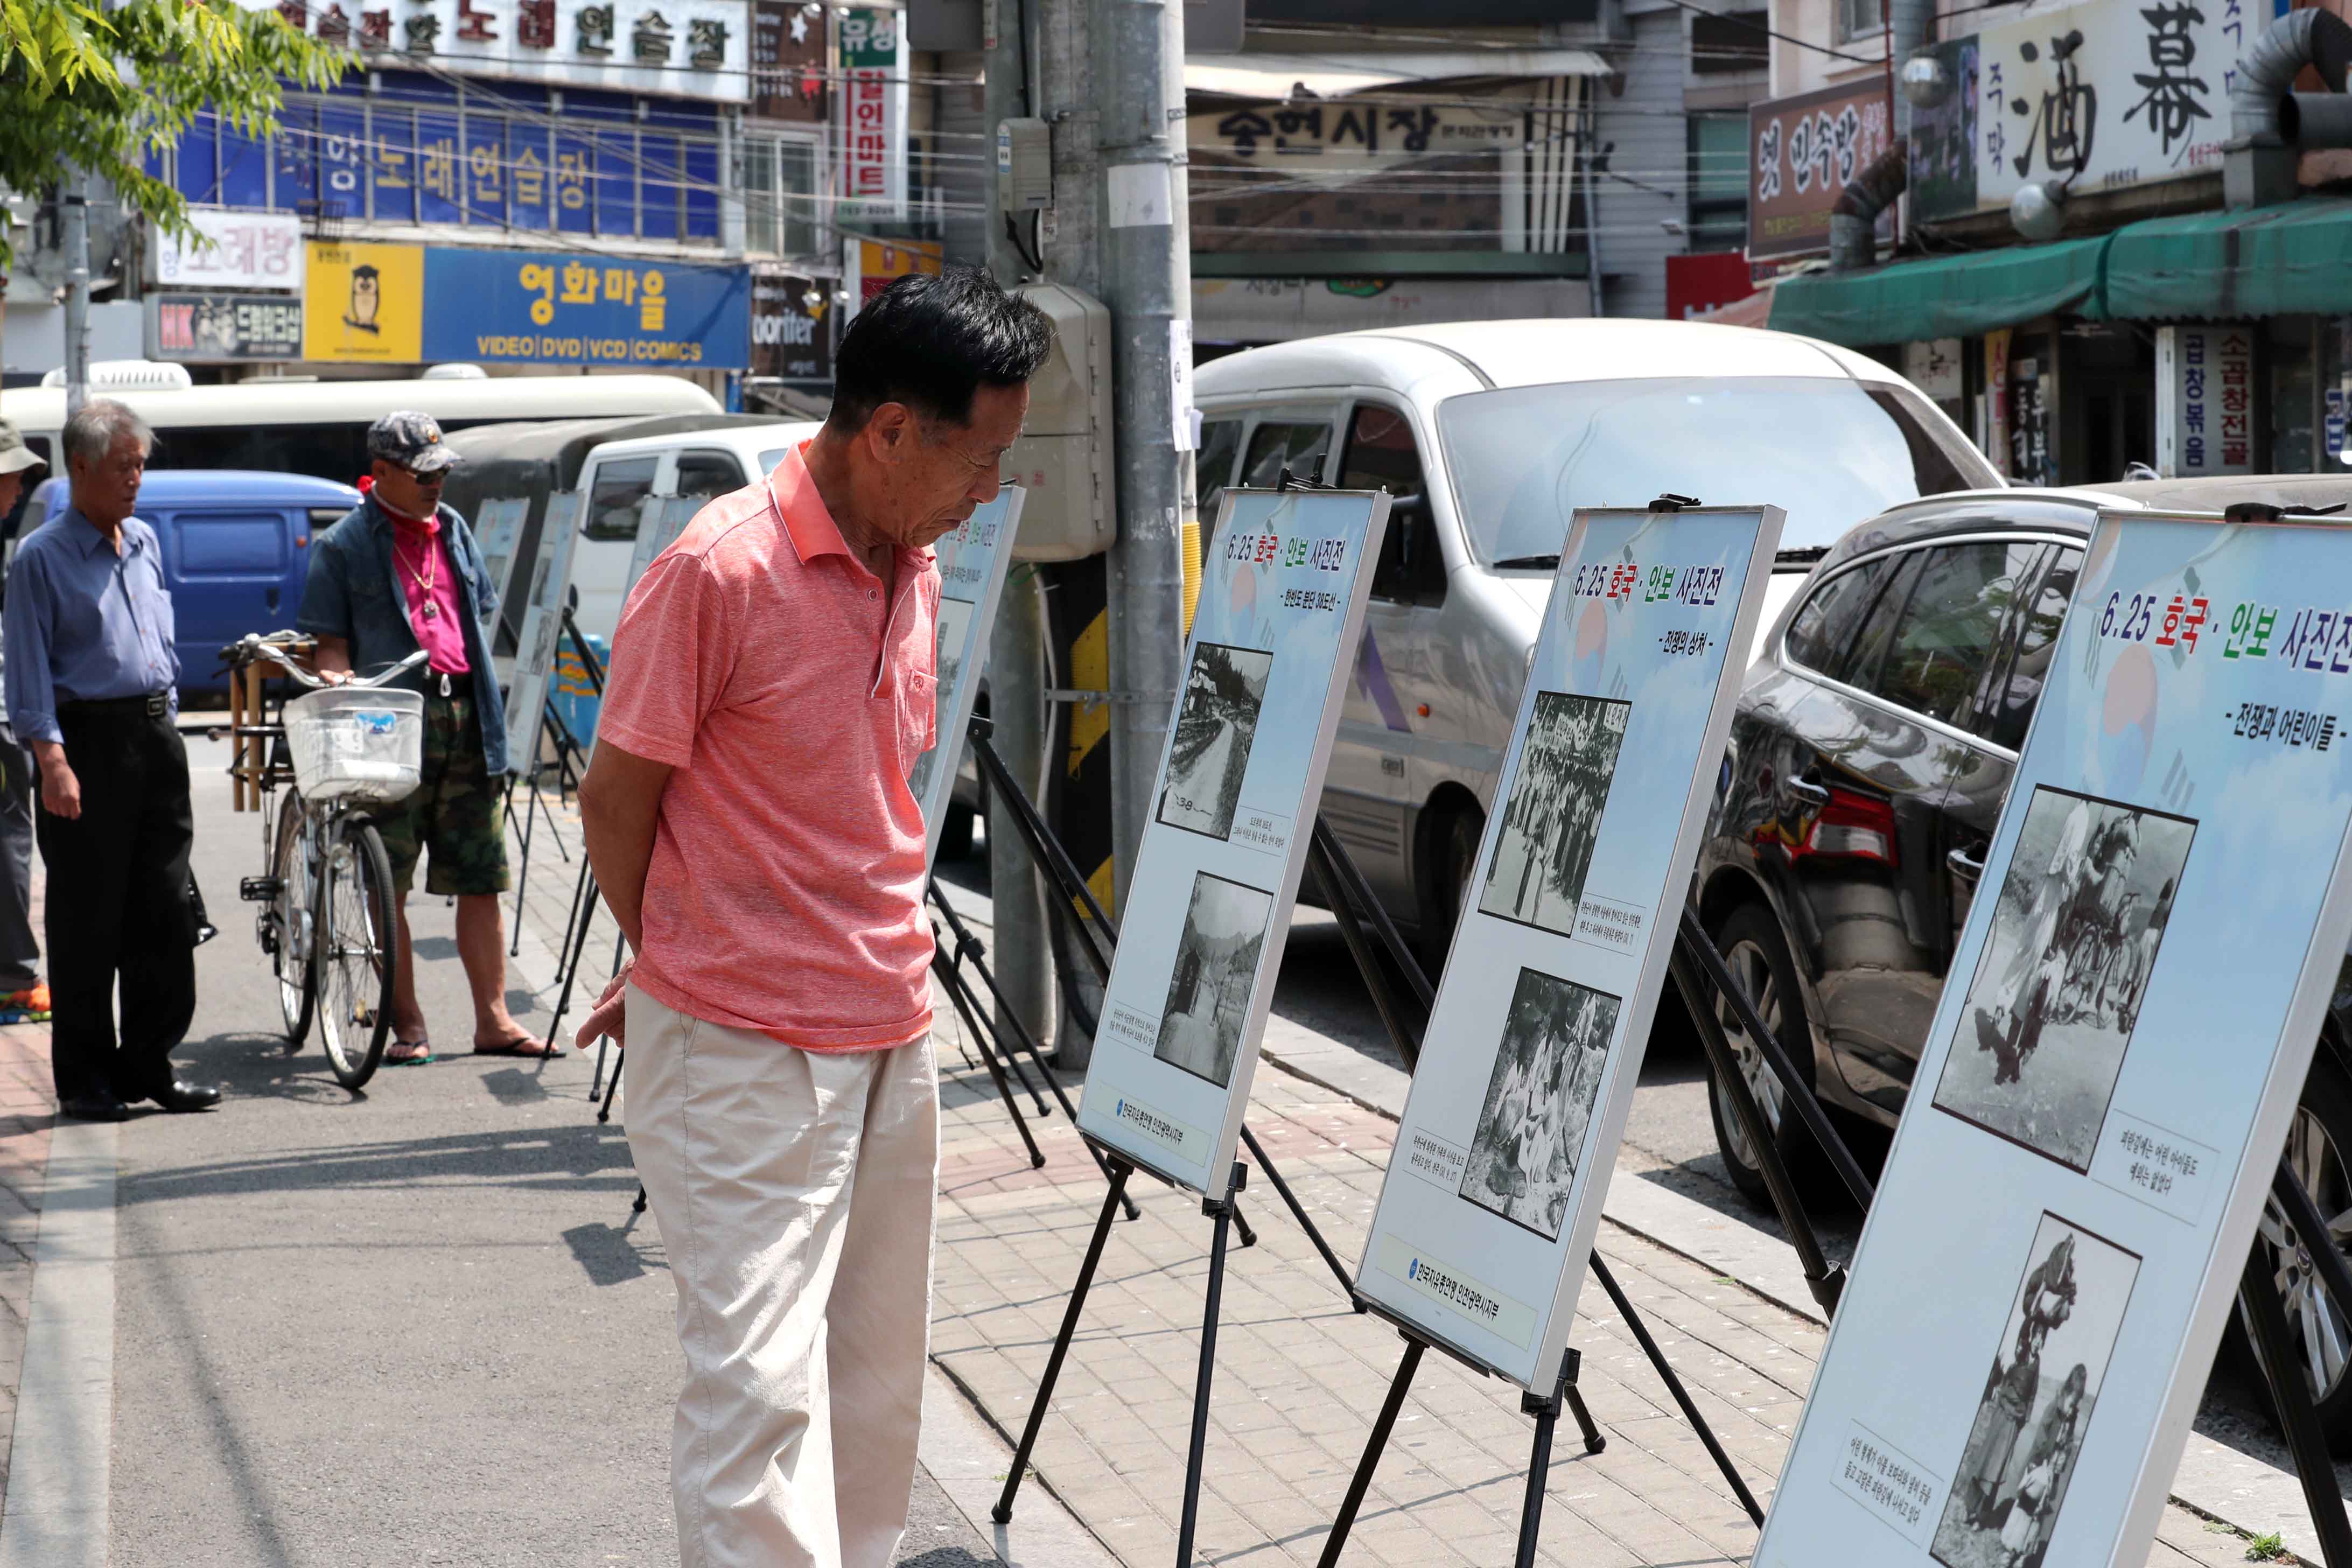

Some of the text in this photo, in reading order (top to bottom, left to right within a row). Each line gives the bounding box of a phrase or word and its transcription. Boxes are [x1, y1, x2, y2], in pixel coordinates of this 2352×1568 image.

[857, 69, 887, 195] 할인마트
[1218, 107, 1440, 156] 송현시장
[1987, 62, 2005, 176] 주막
[376, 134, 586, 209] 노래연습장
[519, 261, 667, 331] 영화마을
[161, 304, 194, 350] HK
[477, 336, 702, 361] VIDEO DVD VCD COMICS
[2185, 334, 2206, 468] 곱창볶음
[2221, 334, 2249, 466] 소곱창전골
[1228, 535, 1254, 561] 6.25
[1254, 535, 1278, 565] 호국
[1285, 537, 1308, 567] 안보
[1310, 540, 1345, 571] 사진전
[1284, 589, 1302, 607] 한반도
[1301, 591, 1315, 610] 분단
[1315, 593, 1337, 611] 38도선
[1575, 565, 1607, 597] 6.25
[1607, 564, 1637, 602] 호국
[1645, 565, 1676, 602] 안보
[1676, 566, 1724, 605] 사진전
[1663, 630, 1690, 655] 전쟁의
[1688, 632, 1707, 656] 상처
[2100, 591, 2157, 641] 6.25
[2155, 596, 2209, 654] 호국
[2223, 603, 2278, 659] 안보
[2234, 703, 2278, 741] 전쟁과
[2278, 709, 2336, 751] 어린이들
[1178, 797, 1193, 810] 38
[1152, 1118, 1183, 1146] 인천광역시지부
[1417, 1263, 1499, 1321] 한국자유총연맹 인천광역시지부
